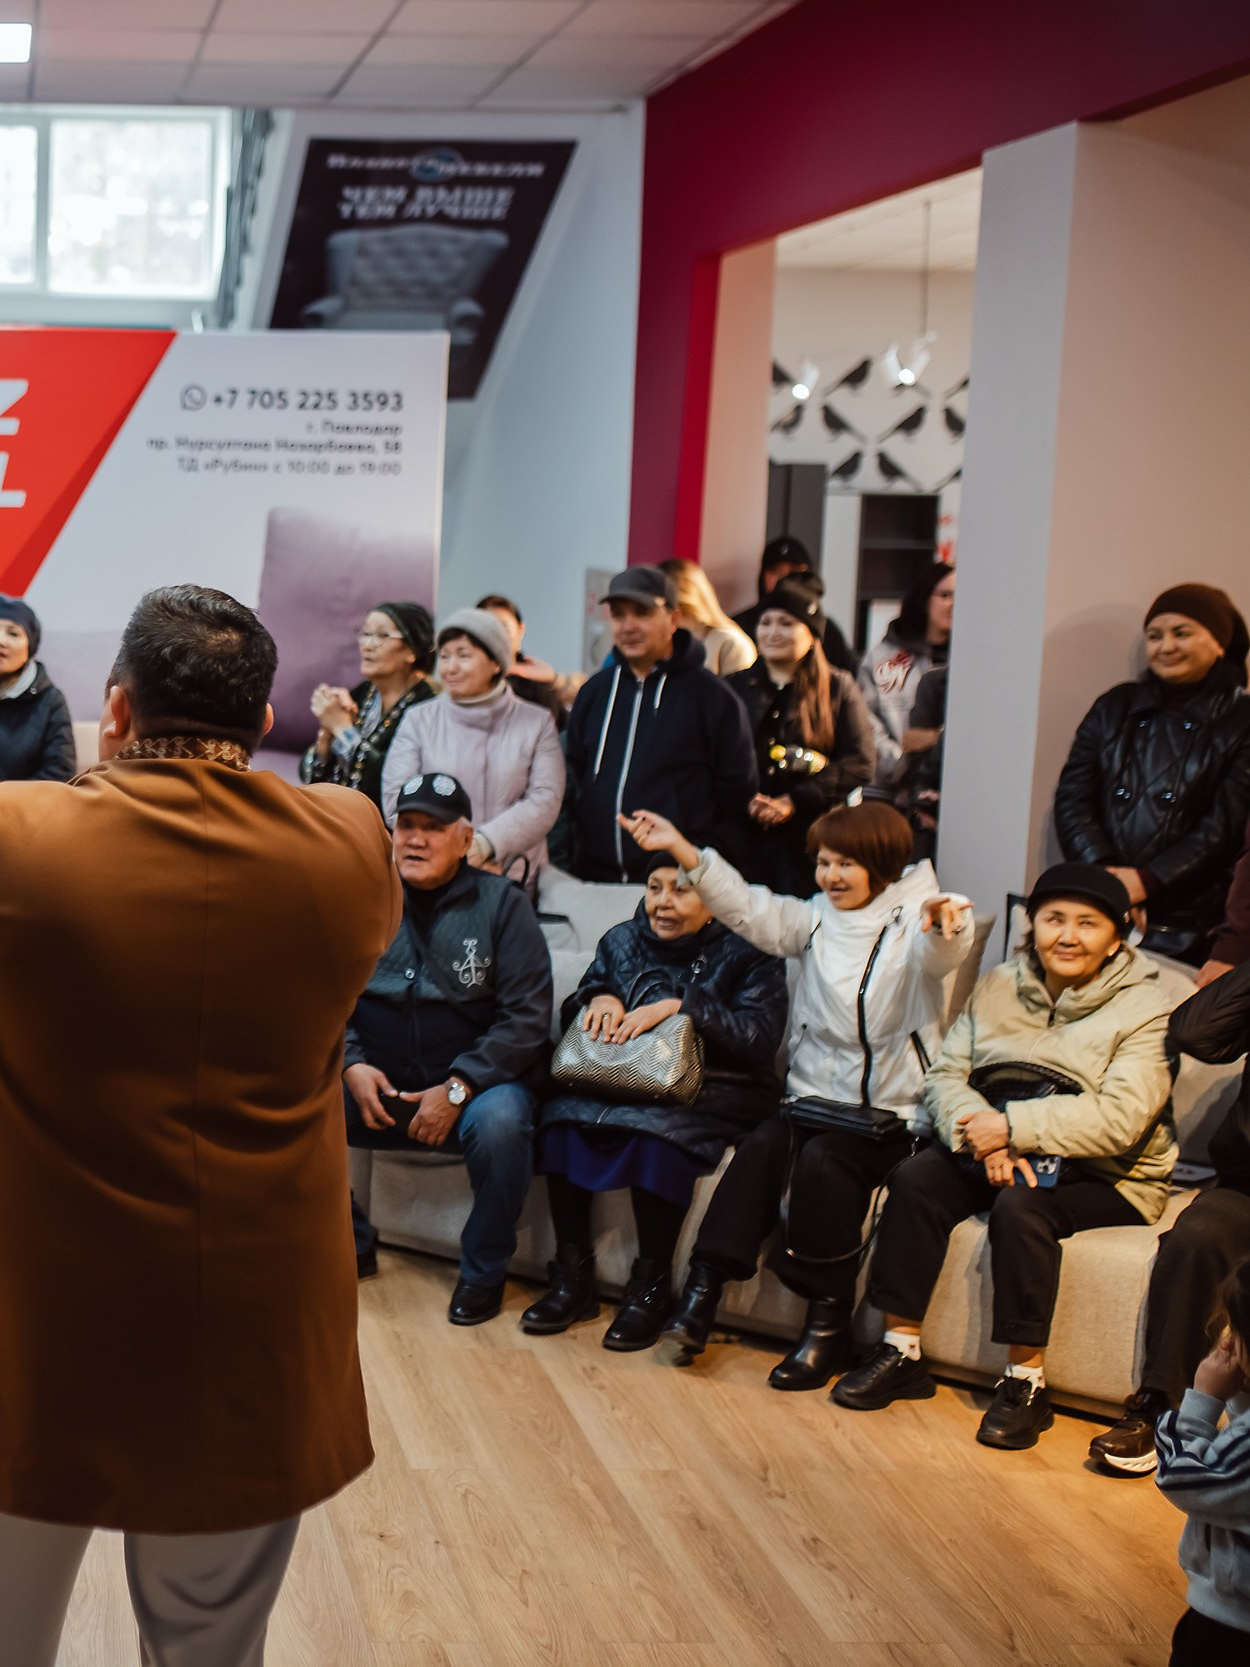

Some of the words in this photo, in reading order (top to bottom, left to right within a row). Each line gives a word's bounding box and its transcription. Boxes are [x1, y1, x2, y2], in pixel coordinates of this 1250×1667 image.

[212, 389, 238, 411] +7
[247, 389, 289, 411] 705
[297, 390, 338, 412] 225
[347, 391, 403, 413] 3593
[321, 419, 403, 437] Павлодар
